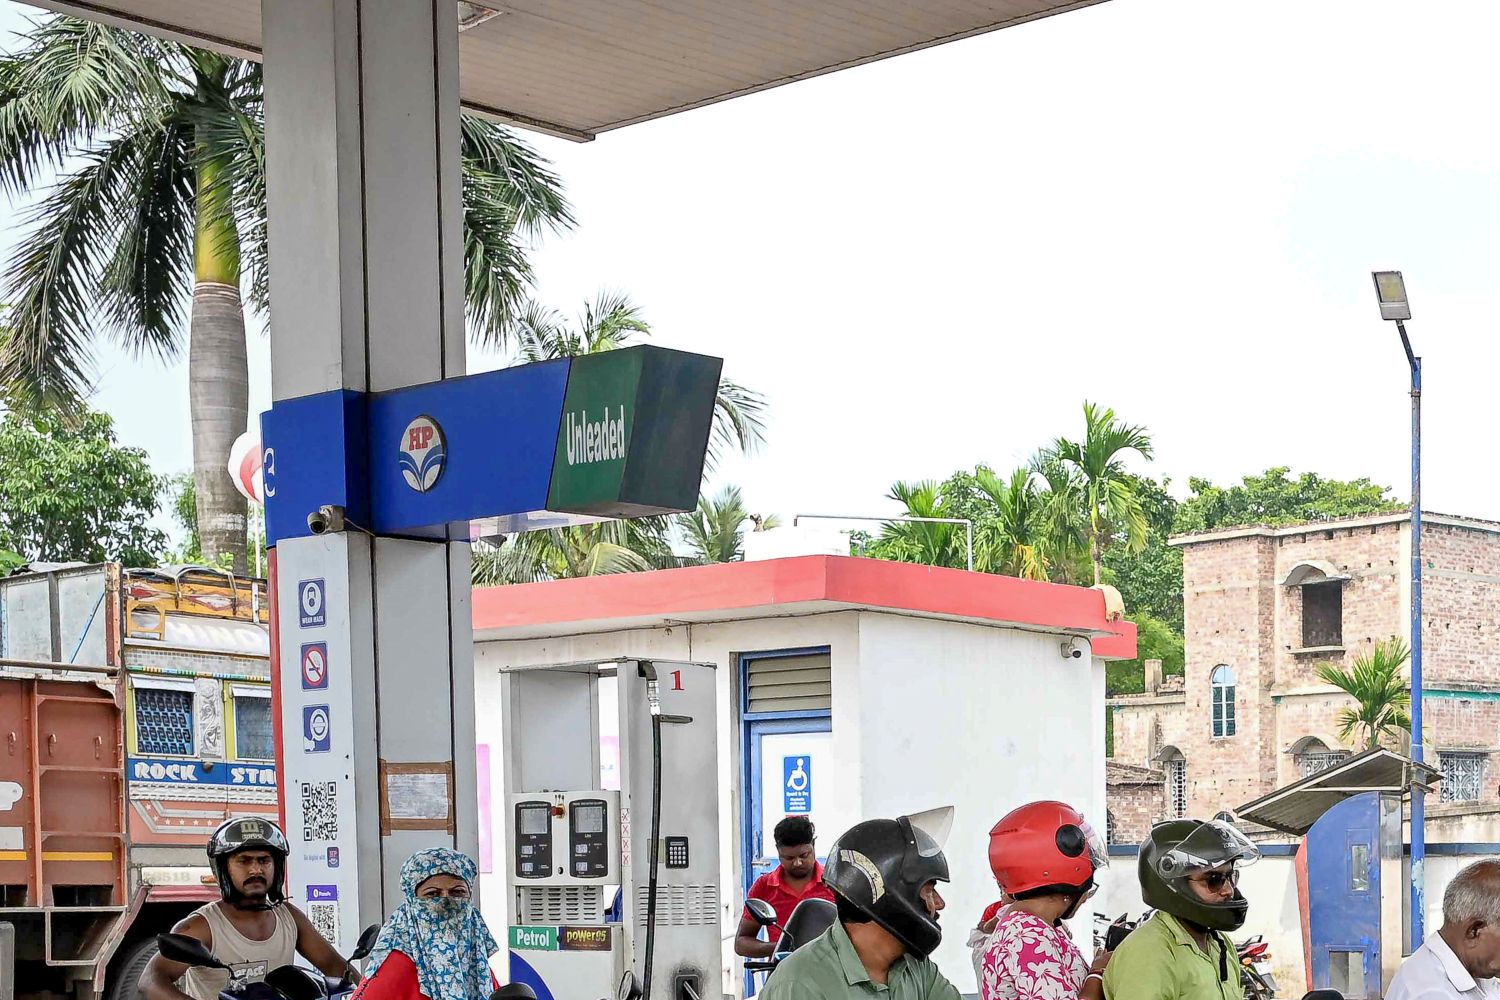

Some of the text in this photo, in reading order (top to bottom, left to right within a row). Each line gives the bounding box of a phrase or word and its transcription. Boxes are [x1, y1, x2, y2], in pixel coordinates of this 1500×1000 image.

[409, 425, 434, 451] HP
[566, 404, 625, 466] Unleaded
[669, 670, 685, 691] 1
[134, 761, 278, 785] ROCK STA
[516, 928, 550, 947] Petrol
